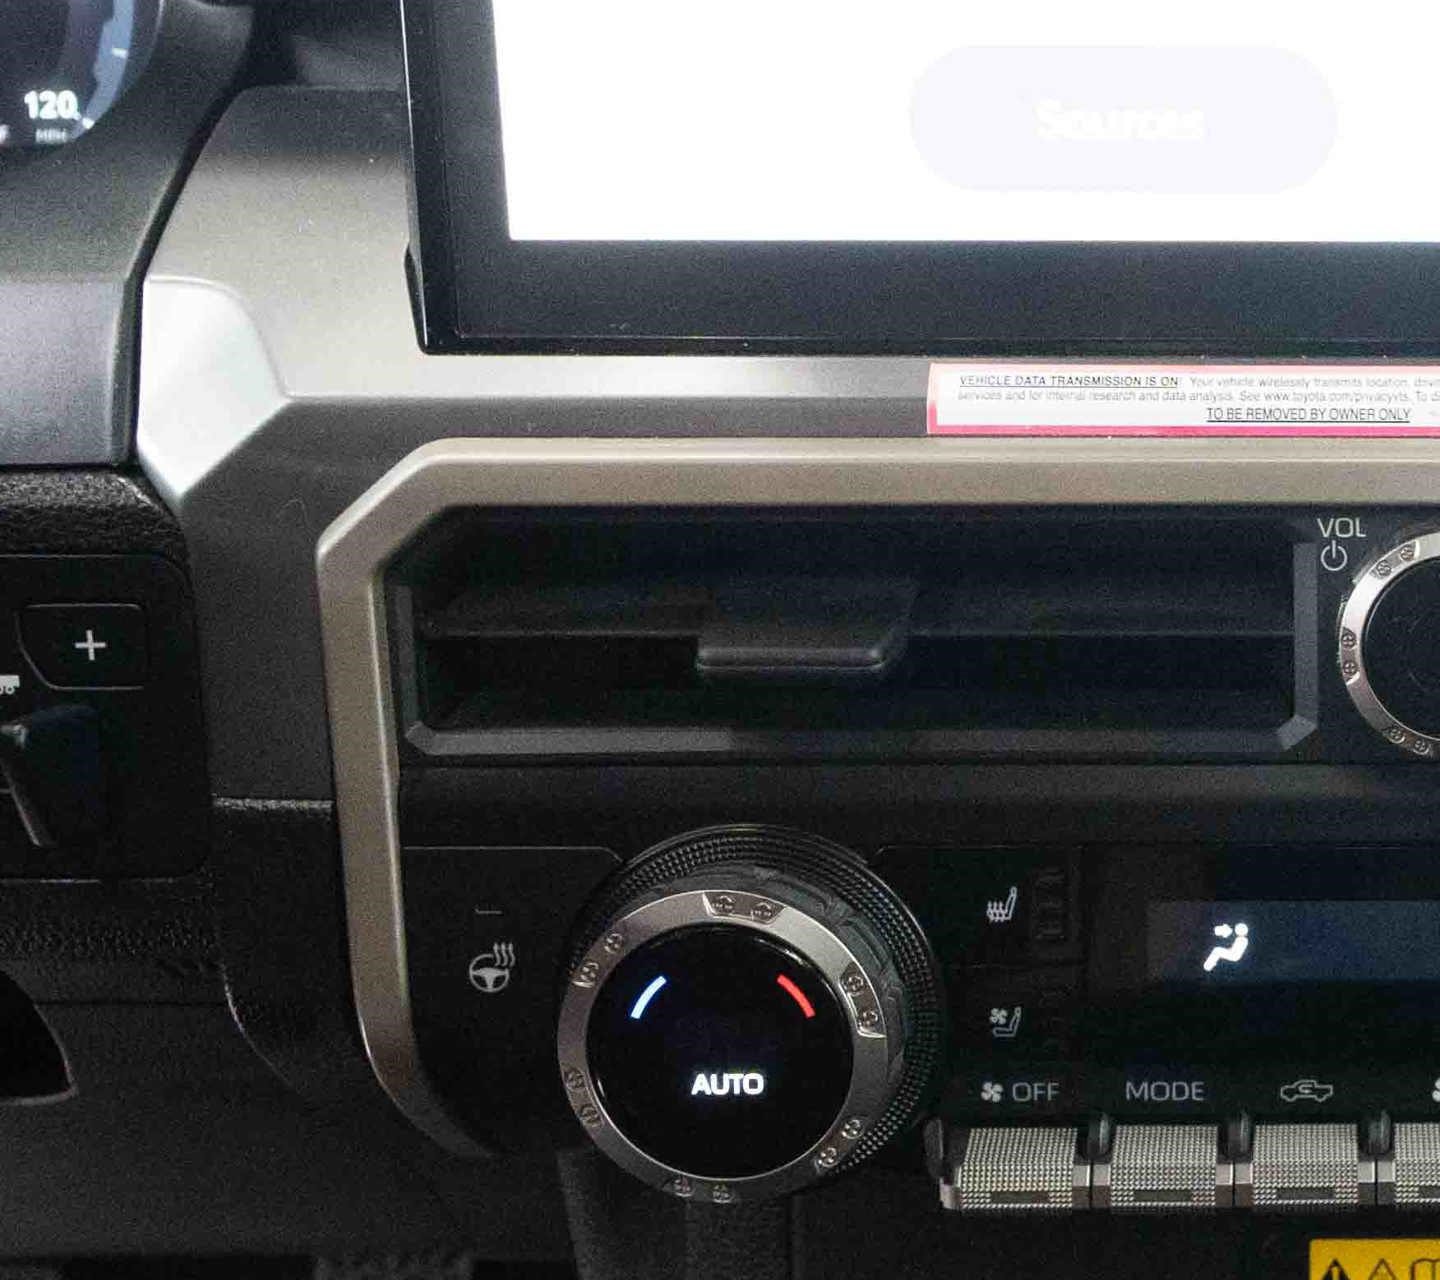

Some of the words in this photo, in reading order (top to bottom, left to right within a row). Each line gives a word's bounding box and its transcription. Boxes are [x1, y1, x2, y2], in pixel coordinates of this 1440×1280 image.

[24, 89, 79, 120] 120
[959, 375, 1011, 386] VEHICLE
[1015, 375, 1046, 386] DATA
[1051, 375, 1141, 387] TRANSMISSION
[1145, 376, 1157, 387] IS
[1259, 377, 1310, 389] wirelessly
[958, 391, 1002, 401] services
[1005, 390, 1025, 401] and
[1028, 390, 1043, 401] for
[1089, 390, 1135, 401] research
[1138, 391, 1159, 401] and
[1161, 391, 1185, 401] data
[1240, 391, 1260, 401] See
[1416, 392, 1428, 402] To
[1207, 408, 1224, 420] TO
[1226, 408, 1242, 420] BE
[1246, 408, 1305, 420] REMOVED
[1310, 408, 1326, 420] BY
[1328, 408, 1376, 421] OWNER
[1378, 408, 1413, 421] ONLY
[1317, 517, 1367, 538] VOL
[691, 1073, 765, 1097] AUTO
[1011, 1082, 1061, 1102] OFF
[1126, 1080, 1206, 1102] MODE
